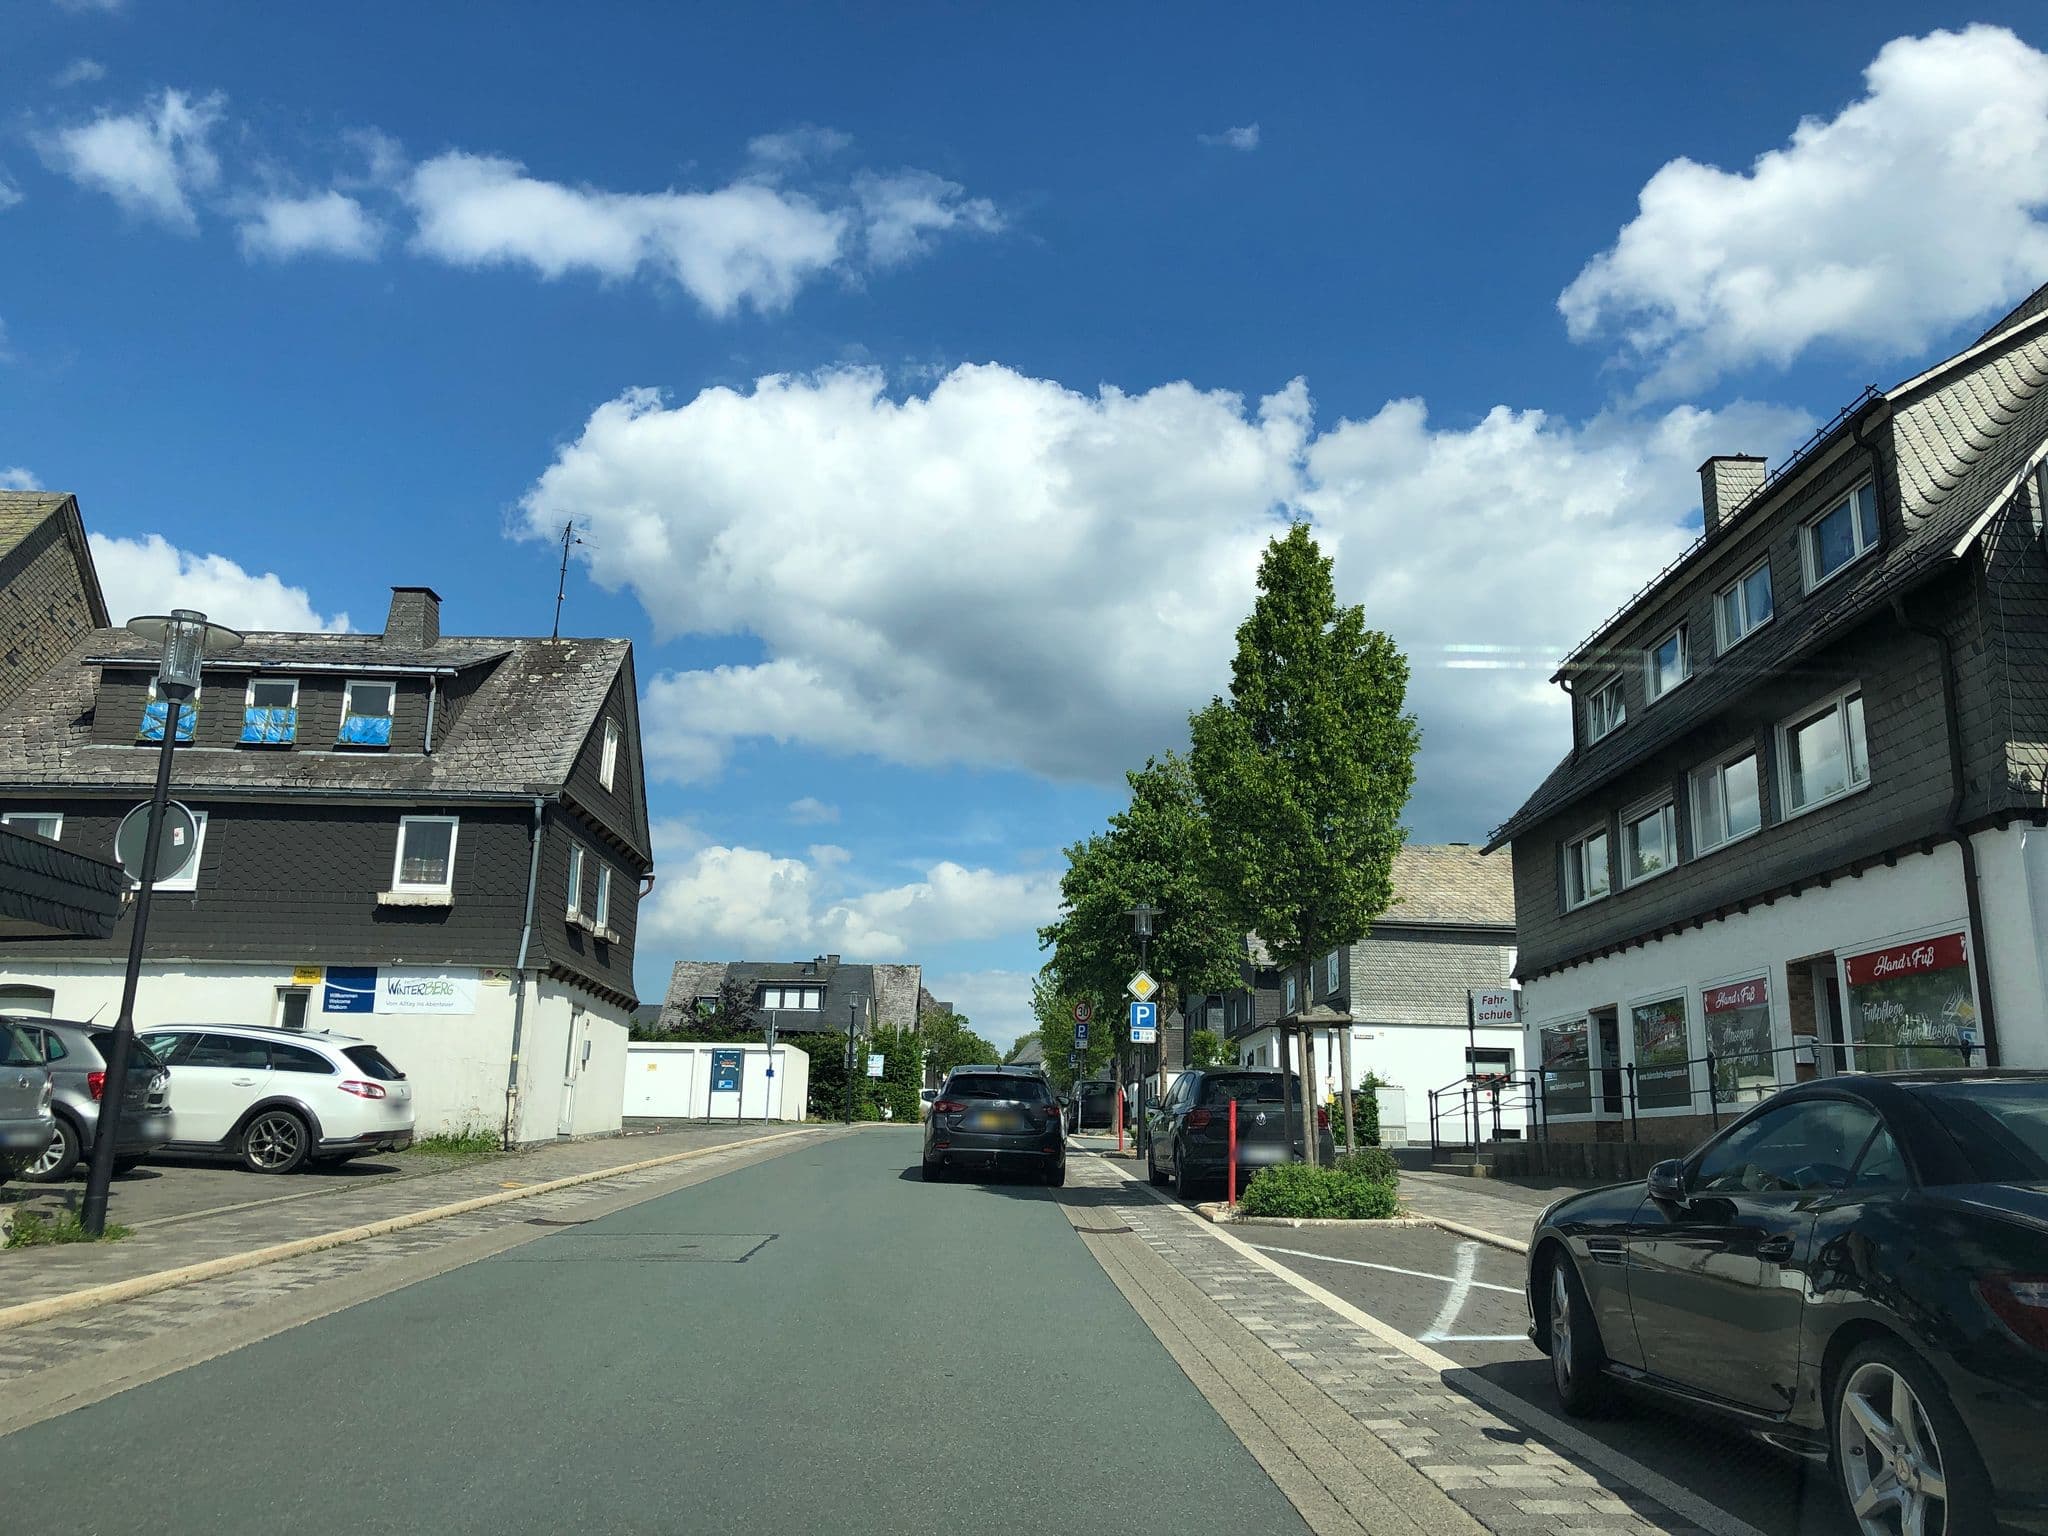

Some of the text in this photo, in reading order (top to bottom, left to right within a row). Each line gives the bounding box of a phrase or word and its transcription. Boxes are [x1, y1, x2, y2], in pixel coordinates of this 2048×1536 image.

[1873, 953, 1905, 976] Hand
[1911, 946, 1935, 968] Fuß
[1482, 994, 1508, 1005] Fahr-
[1716, 990, 1737, 1009] Hand
[1740, 985, 1756, 1003] Fuß
[1077, 1006, 1088, 1017] 30
[1136, 1006, 1150, 1025] P
[1478, 1010, 1513, 1021] schule
[1078, 1025, 1086, 1038] P
